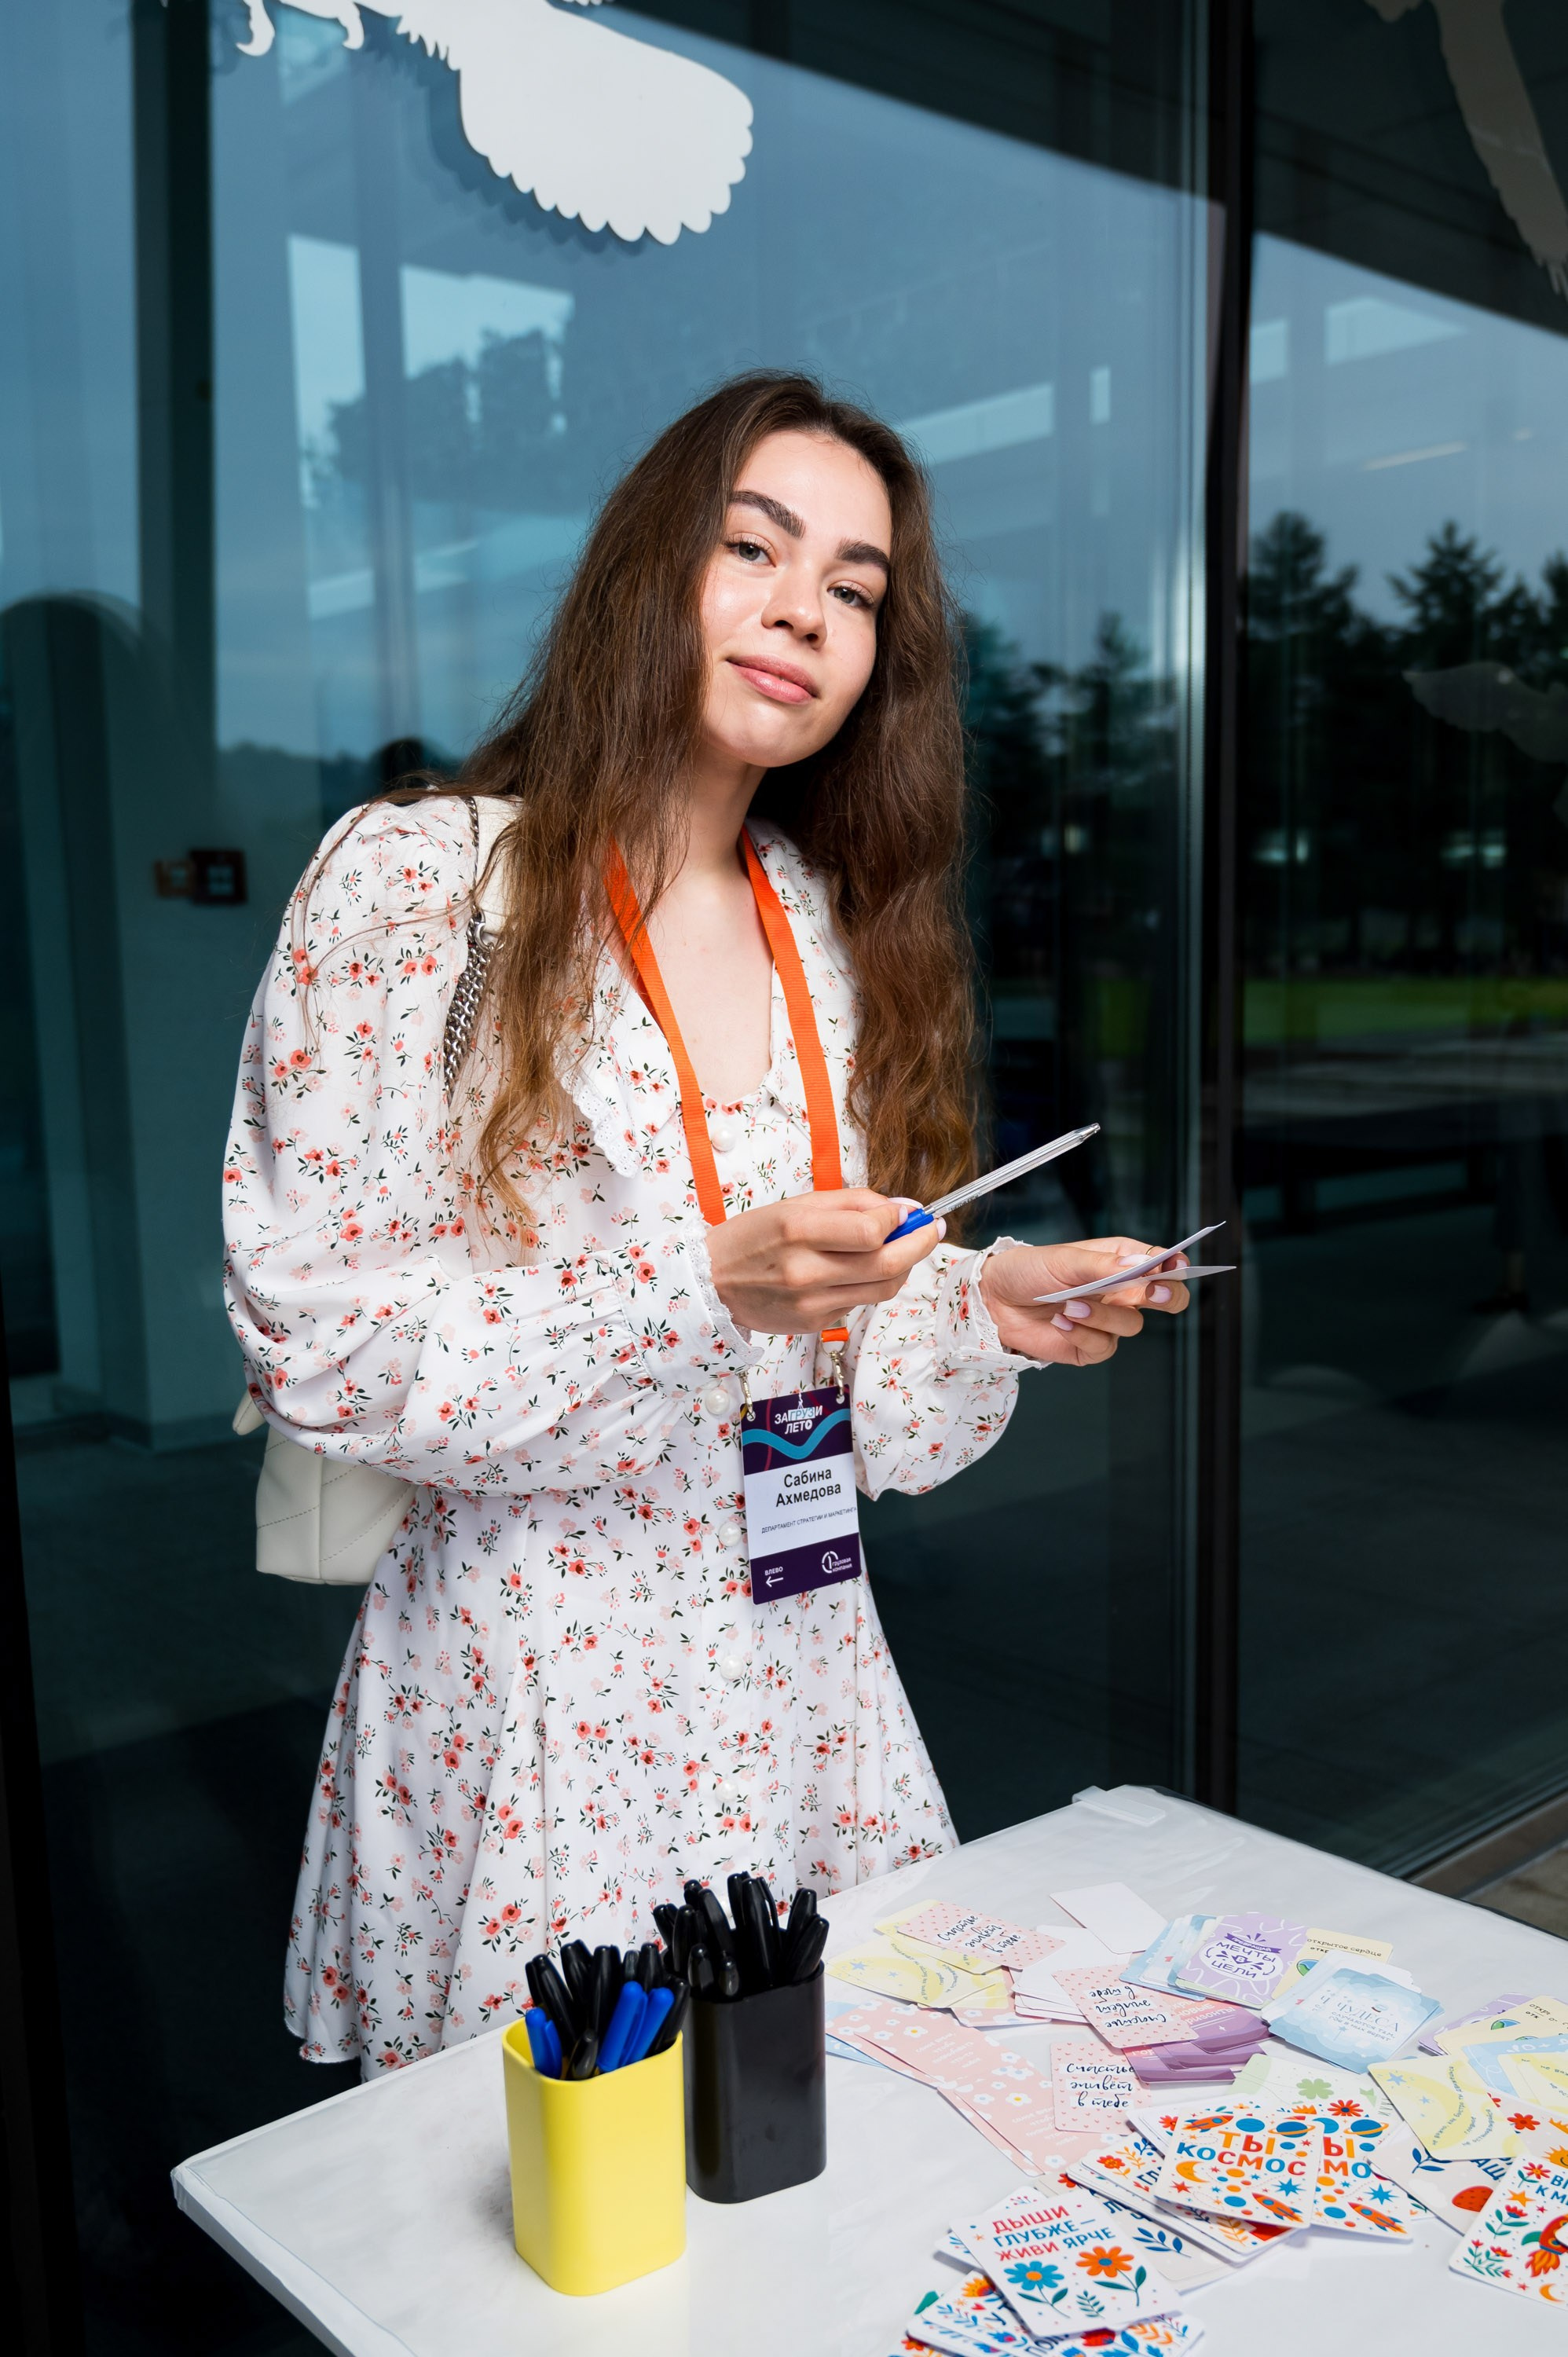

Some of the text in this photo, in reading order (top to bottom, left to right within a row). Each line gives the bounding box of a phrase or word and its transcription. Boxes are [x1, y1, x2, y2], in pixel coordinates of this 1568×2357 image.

[775, 1405, 823, 1424] ЗАГРУЗИ
[784, 1419, 813, 1435] ЛЕТО
[784, 1468, 832, 1487] Сабина
[775, 1483, 841, 1508] Ахмедова
[761, 1520, 796, 1534] ДЕПАРТАМЕНТ
[797, 1515, 823, 1525] СТРАТЕГИИ
[828, 1507, 856, 1517] МАРКЕТИНГА
[764, 1566, 783, 1575] ВЛЕВО
[937, 1915, 979, 1941] Счастье
[997, 1931, 1020, 1948] тебе
[1306, 1938, 1382, 1957] открытое сердце
[1216, 1942, 1276, 1963] МЕЧТЫ
[1211, 1960, 1257, 1978] ЦЕЛИ
[1089, 1988, 1122, 2003] тебе
[1105, 2013, 1167, 2028] Счастье
[1337, 2002, 1398, 2033] ЧУДЕСА
[1066, 2062, 1135, 2074] Счастье
[1070, 2074, 1133, 2091] живёт
[1078, 2091, 1129, 2108] в тебе
[1218, 2130, 1276, 2155] ТЫ
[1323, 2136, 1355, 2159] Ы
[1176, 2142, 1306, 2176] КОСМОС
[992, 2205, 1070, 2234] ДЫШИ
[993, 2220, 1079, 2247] ГЛУБЖЕ
[995, 2227, 1116, 2261] ЖИВИ ЯРЧЕ
